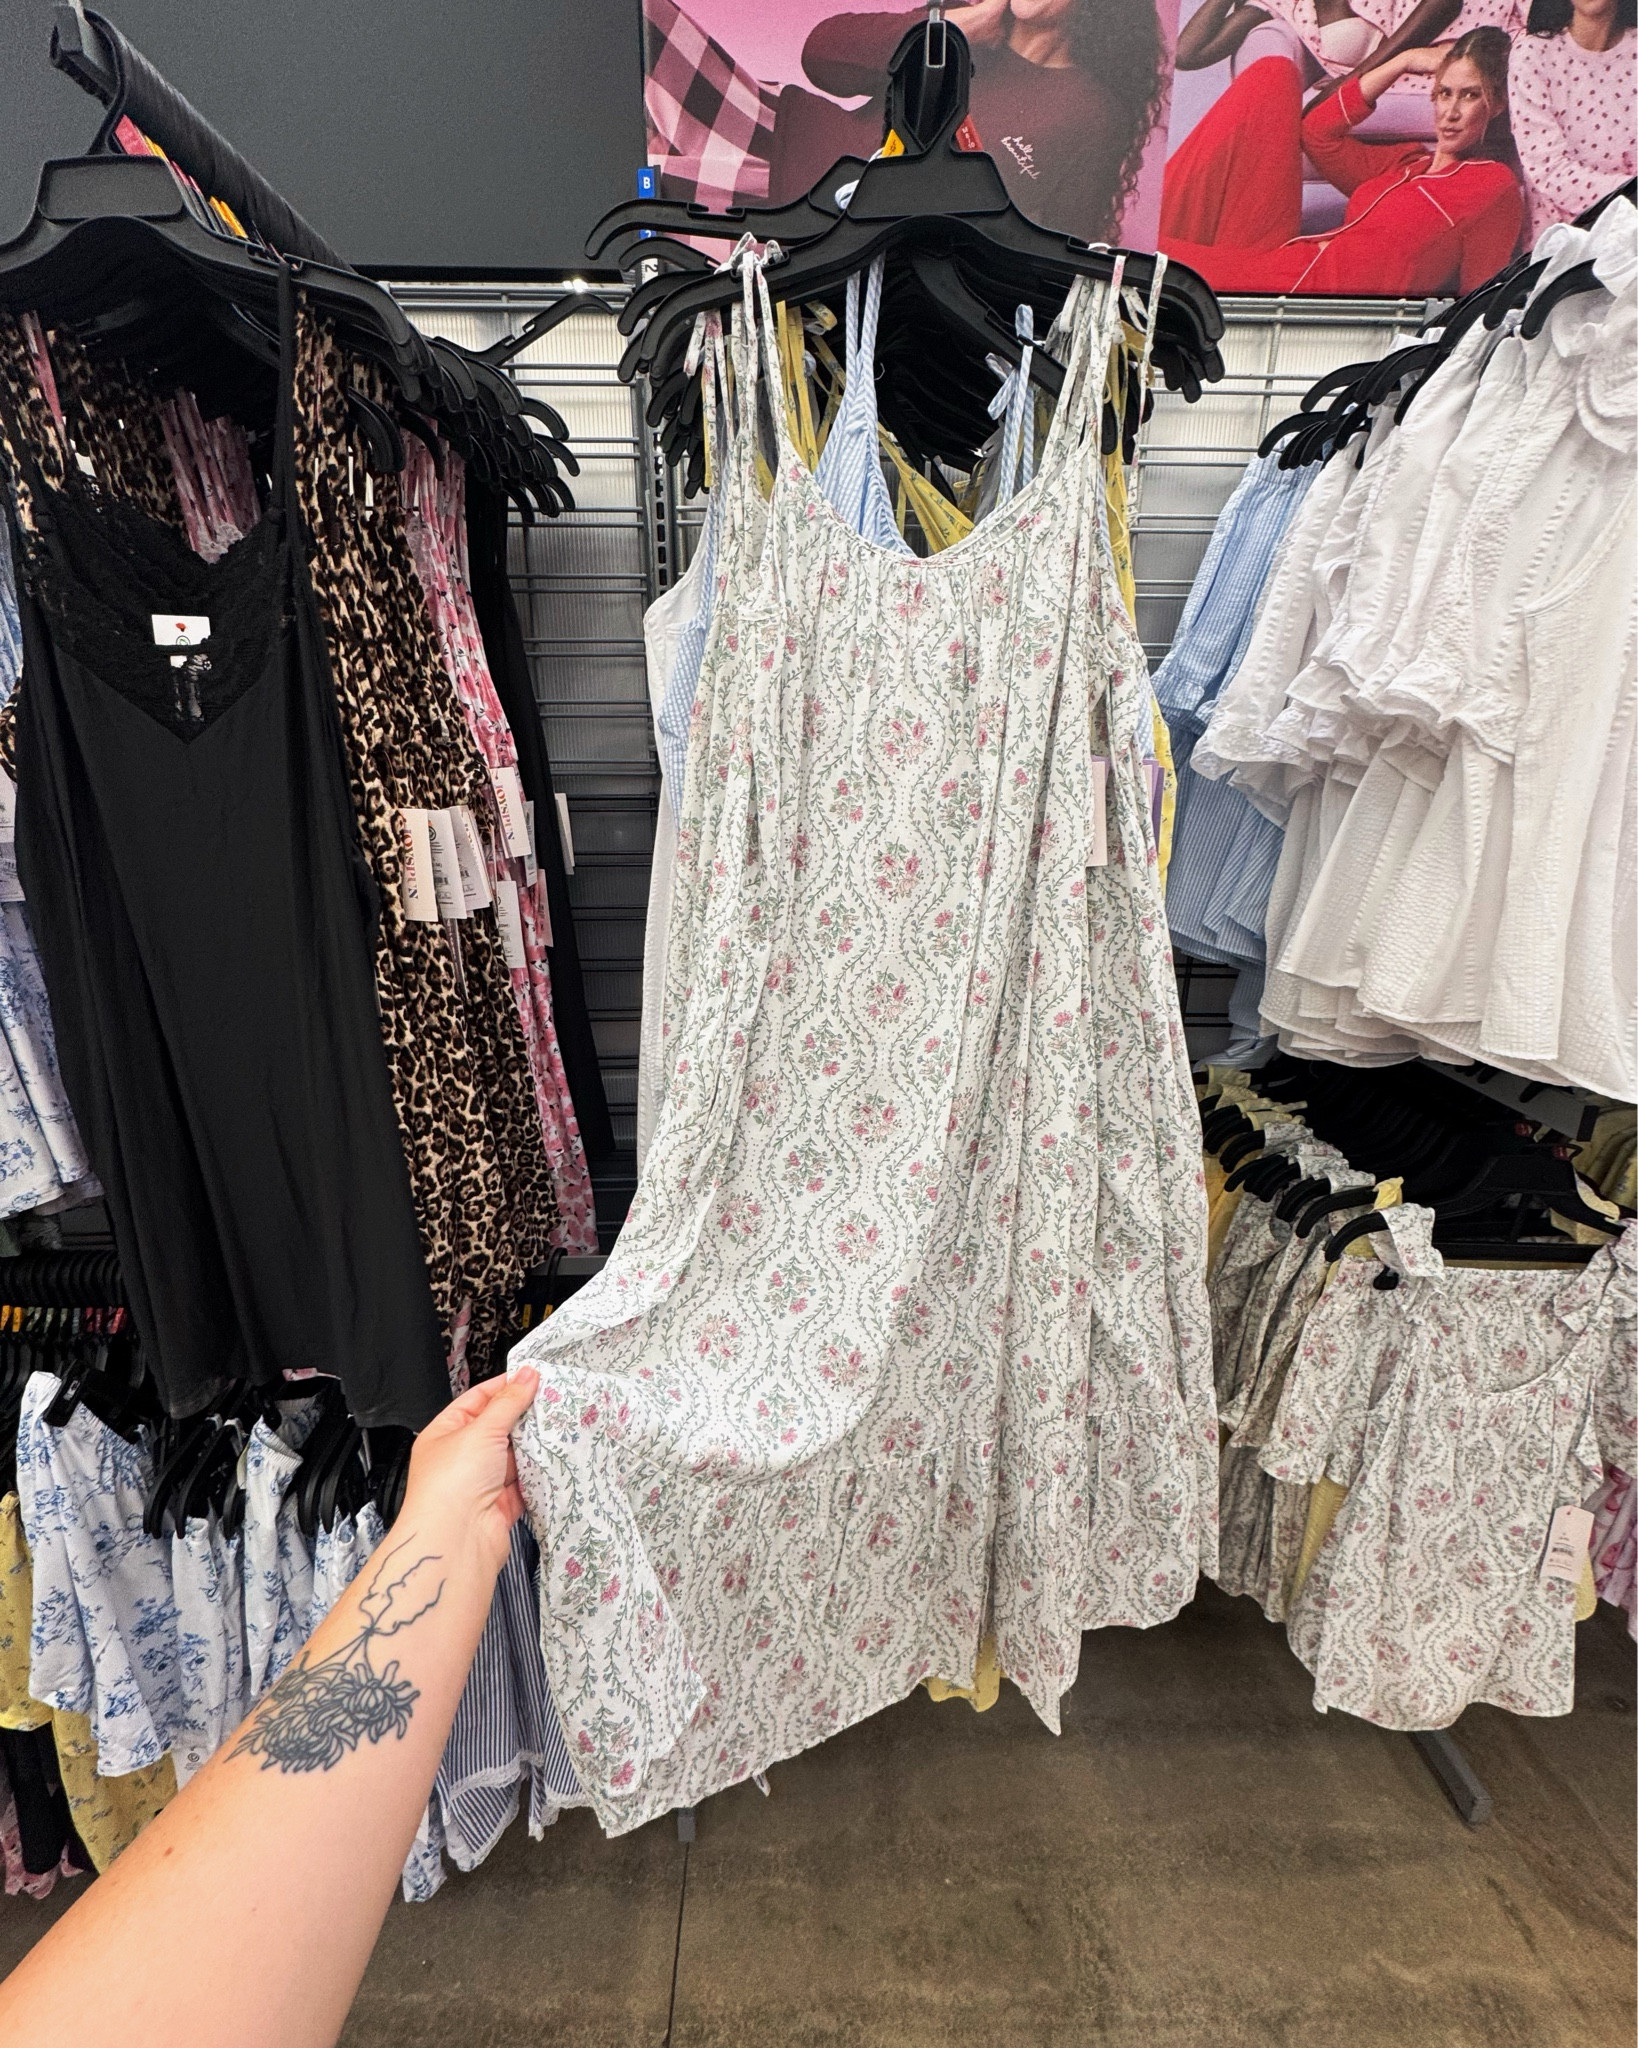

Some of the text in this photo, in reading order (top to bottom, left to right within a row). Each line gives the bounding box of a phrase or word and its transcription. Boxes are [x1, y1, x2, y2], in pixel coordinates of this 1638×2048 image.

[1000, 136, 1041, 180] beautiful
[1012, 136, 1034, 162] hello
[643, 176, 651, 190] B
[494, 784, 515, 840] JOYSPUN
